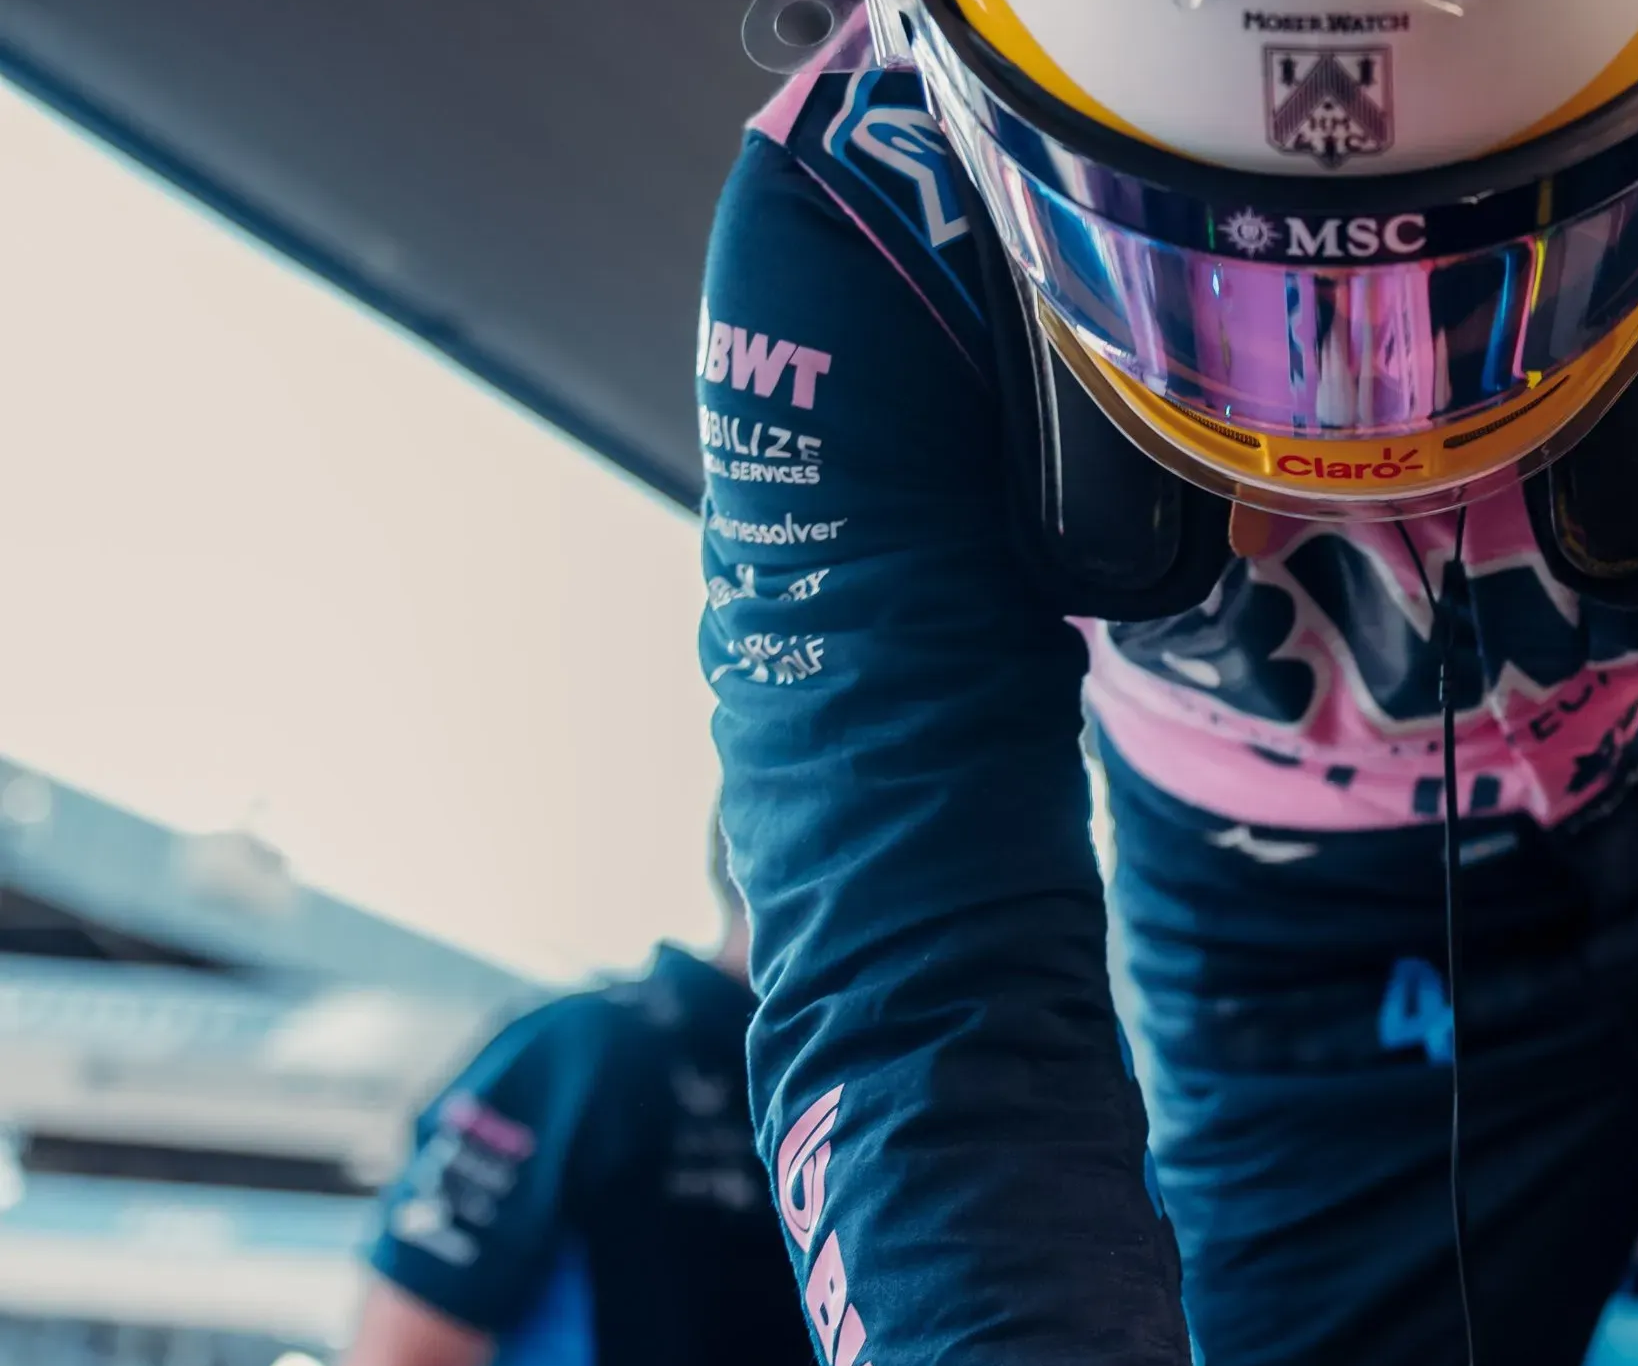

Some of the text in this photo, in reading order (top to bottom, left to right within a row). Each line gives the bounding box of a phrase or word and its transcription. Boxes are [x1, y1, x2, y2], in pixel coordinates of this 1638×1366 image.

[1285, 214, 1427, 257] MSC
[704, 321, 832, 410] BWT
[730, 460, 820, 484] SERVICES
[1277, 450, 1408, 480] Claro
